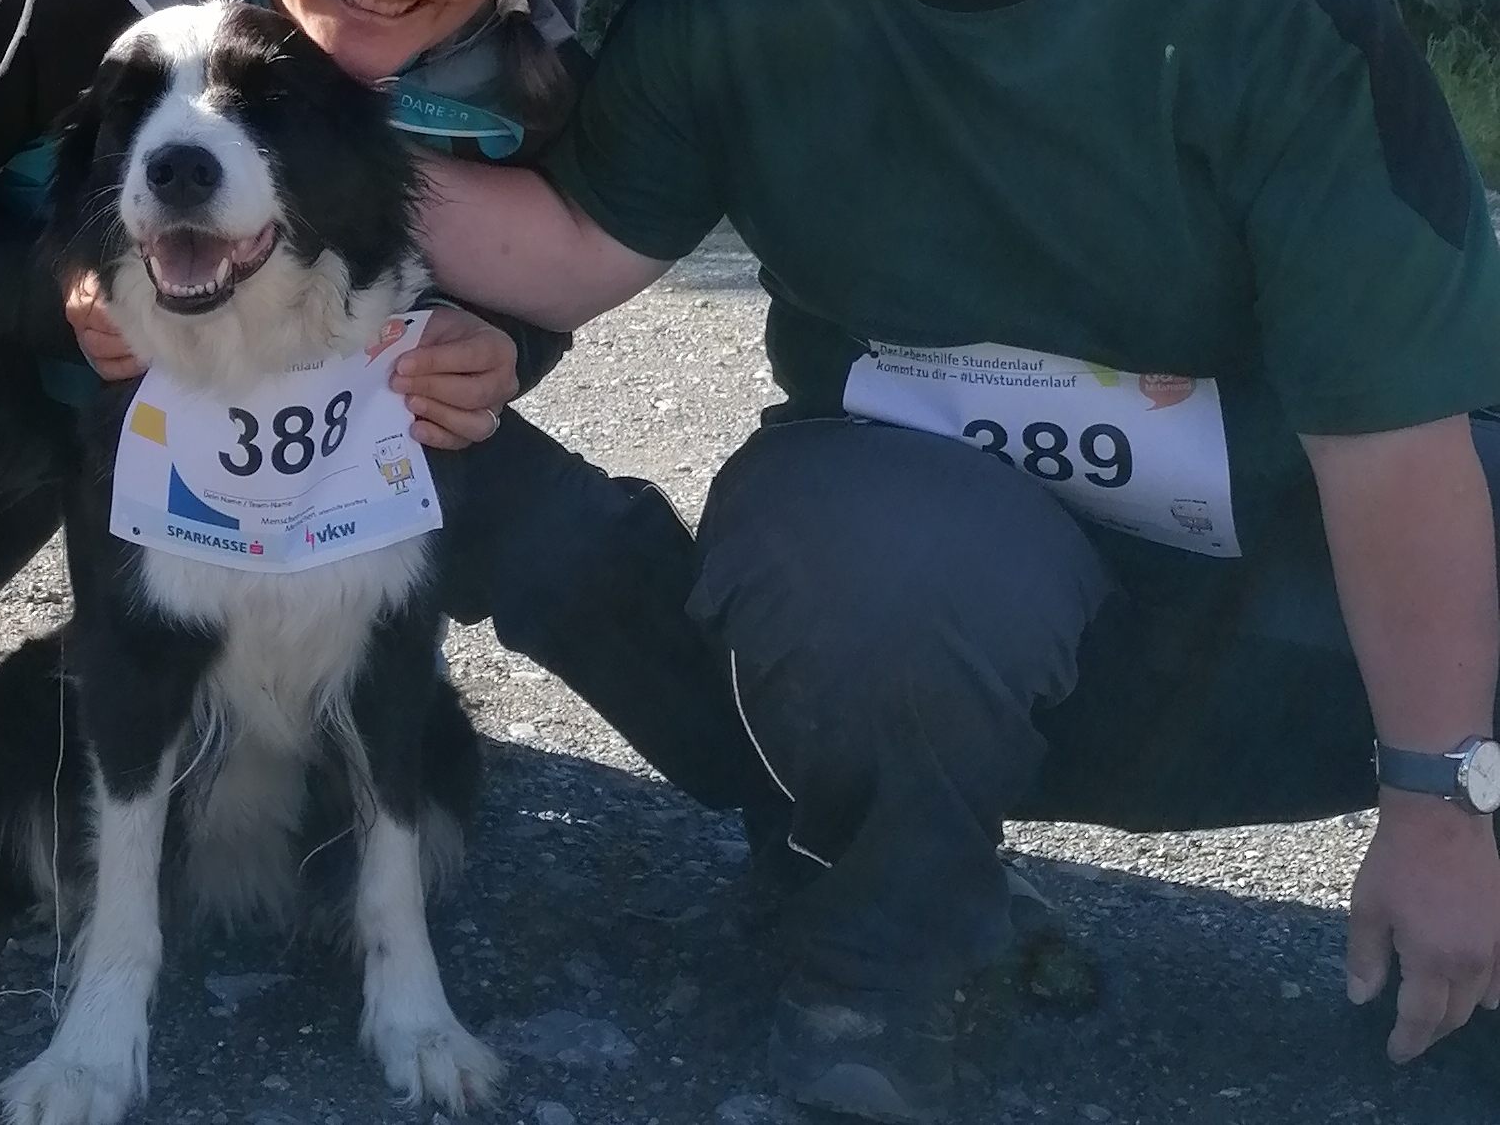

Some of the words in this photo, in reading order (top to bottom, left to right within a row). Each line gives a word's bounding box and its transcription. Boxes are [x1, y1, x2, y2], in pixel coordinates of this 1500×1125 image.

[880, 344, 898, 357] Der
[899, 348, 959, 366] Lebenshilfe
[962, 355, 1044, 372] Stundenlauf
[876, 359, 914, 376] kommt
[915, 368, 929, 379] zu
[932, 368, 947, 380] dir
[960, 373, 1076, 388] #LHVstundenlauf
[218, 390, 353, 476] 388
[962, 419, 1133, 488] 389
[167, 525, 248, 554] SPARKASSE
[316, 521, 356, 544] vkw
